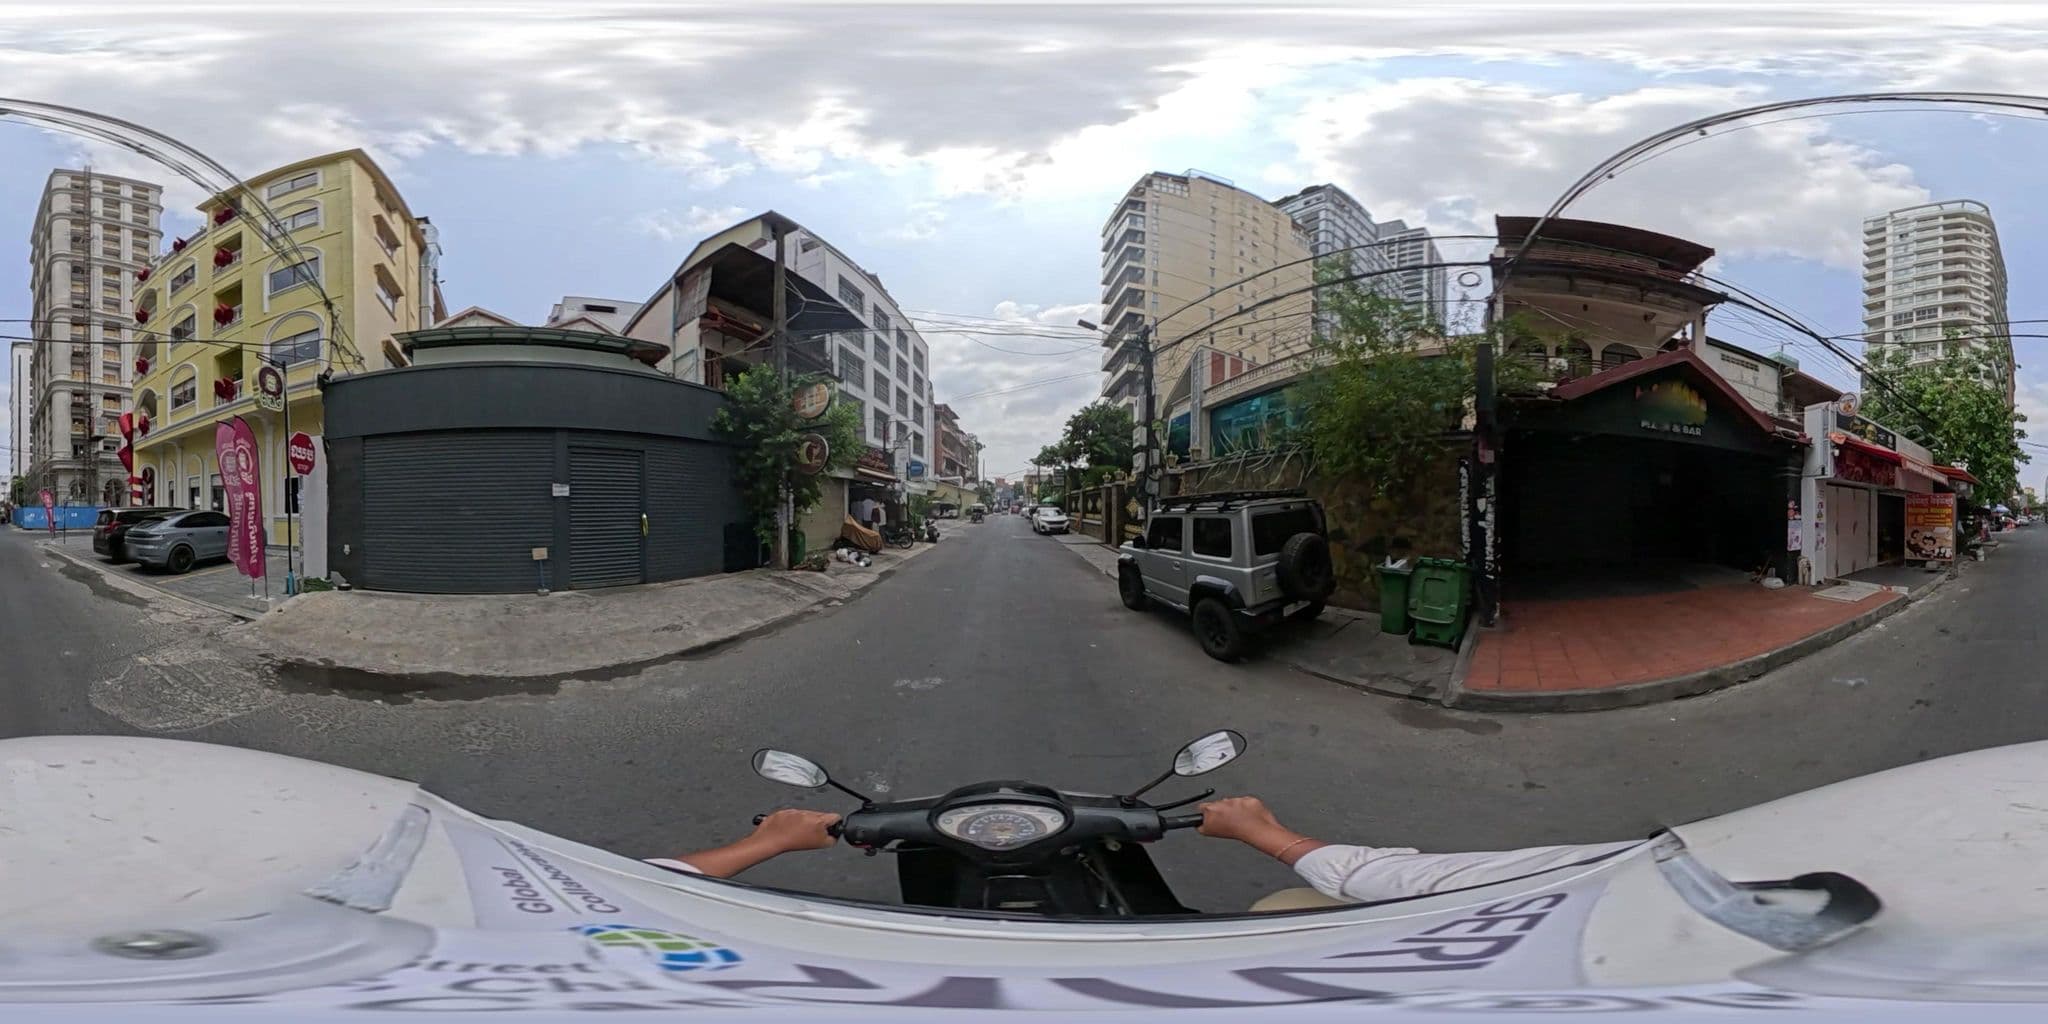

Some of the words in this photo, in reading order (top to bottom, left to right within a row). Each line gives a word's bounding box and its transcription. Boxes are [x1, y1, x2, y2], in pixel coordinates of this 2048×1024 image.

[1682, 425, 1702, 436] BAR
[291, 443, 314, 462] ឈប់
[491, 866, 554, 914] Global
